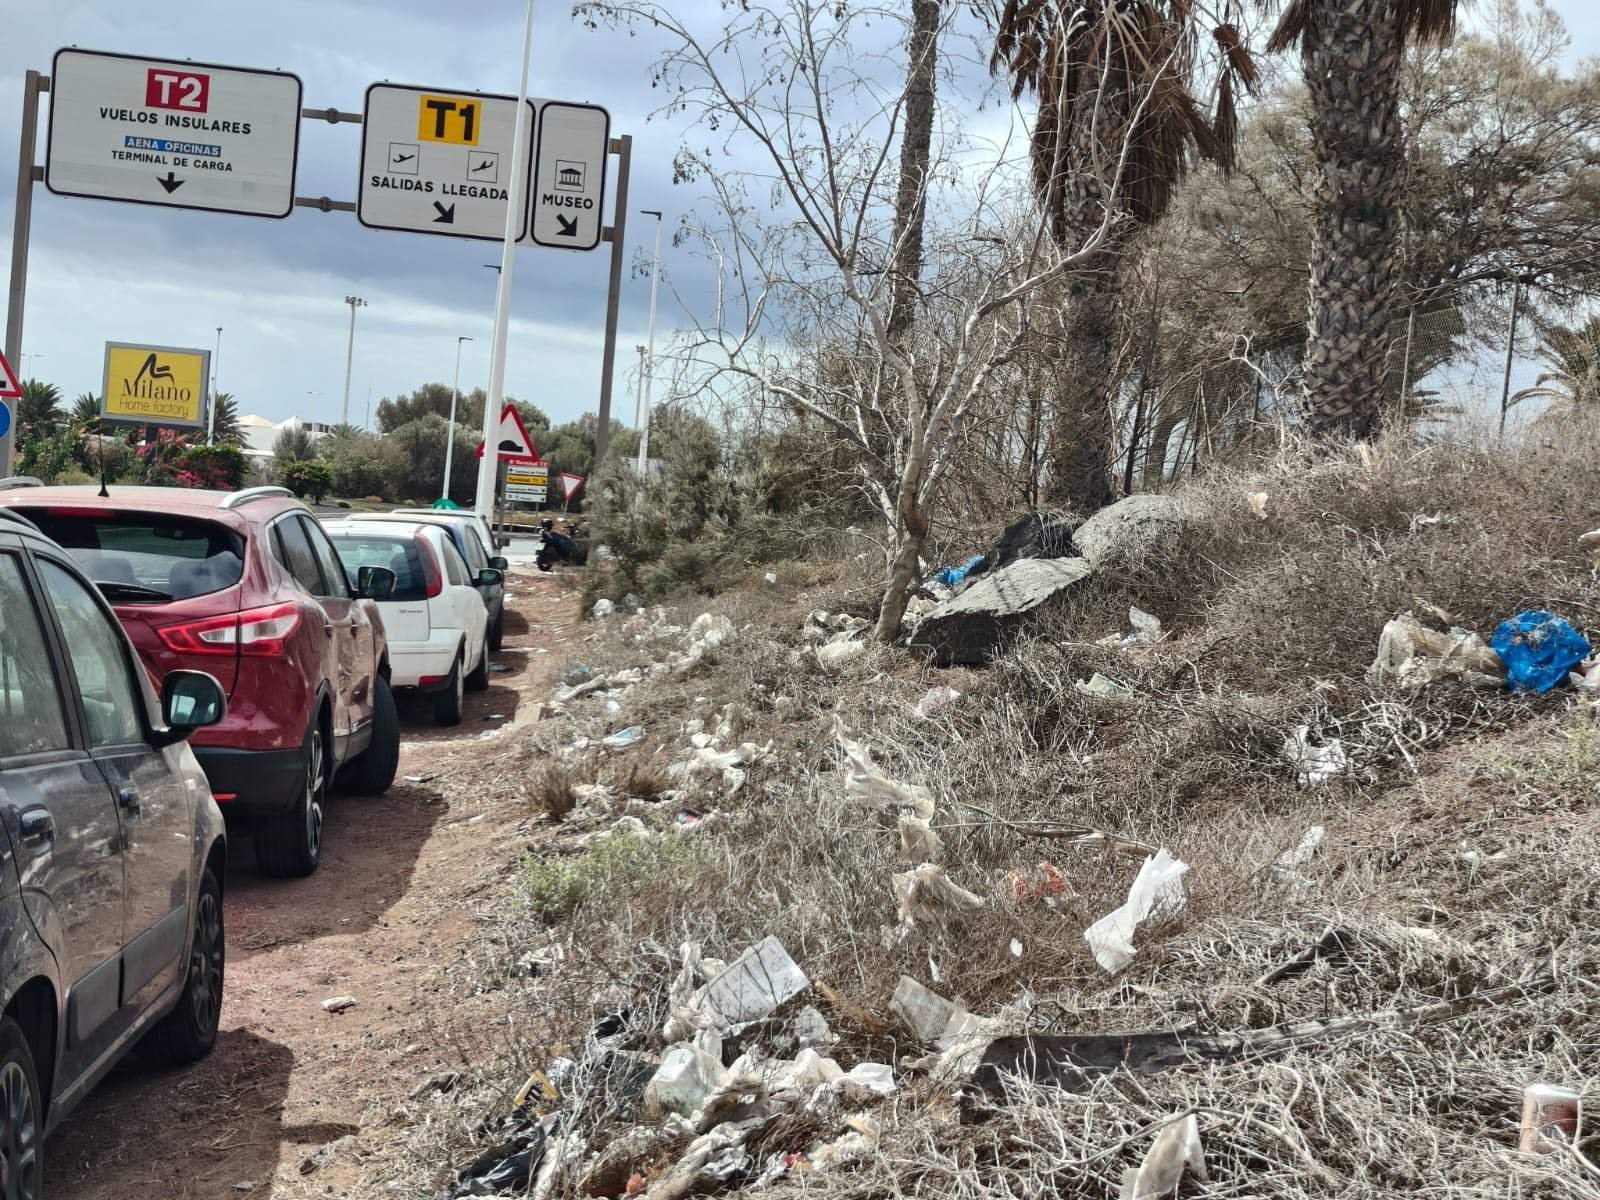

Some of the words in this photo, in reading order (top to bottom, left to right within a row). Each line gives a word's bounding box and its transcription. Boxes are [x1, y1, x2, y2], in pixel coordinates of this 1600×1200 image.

[154, 73, 203, 108] T2
[99, 107, 158, 124] VUELOS
[165, 114, 252, 135] INSULARES
[426, 99, 475, 141] T1
[127, 137, 159, 151] AENA
[164, 142, 220, 156] OFICINAS
[111, 150, 168, 165] TERMINAL
[173, 157, 188, 167] DE
[194, 159, 233, 172] CARGA
[371, 175, 434, 193] SALIDAS
[442, 183, 509, 201] LLEGADA
[542, 193, 594, 210] MUSEO
[121, 378, 191, 401] Milano
[119, 399, 150, 411] Home
[153, 401, 189, 416] factory
